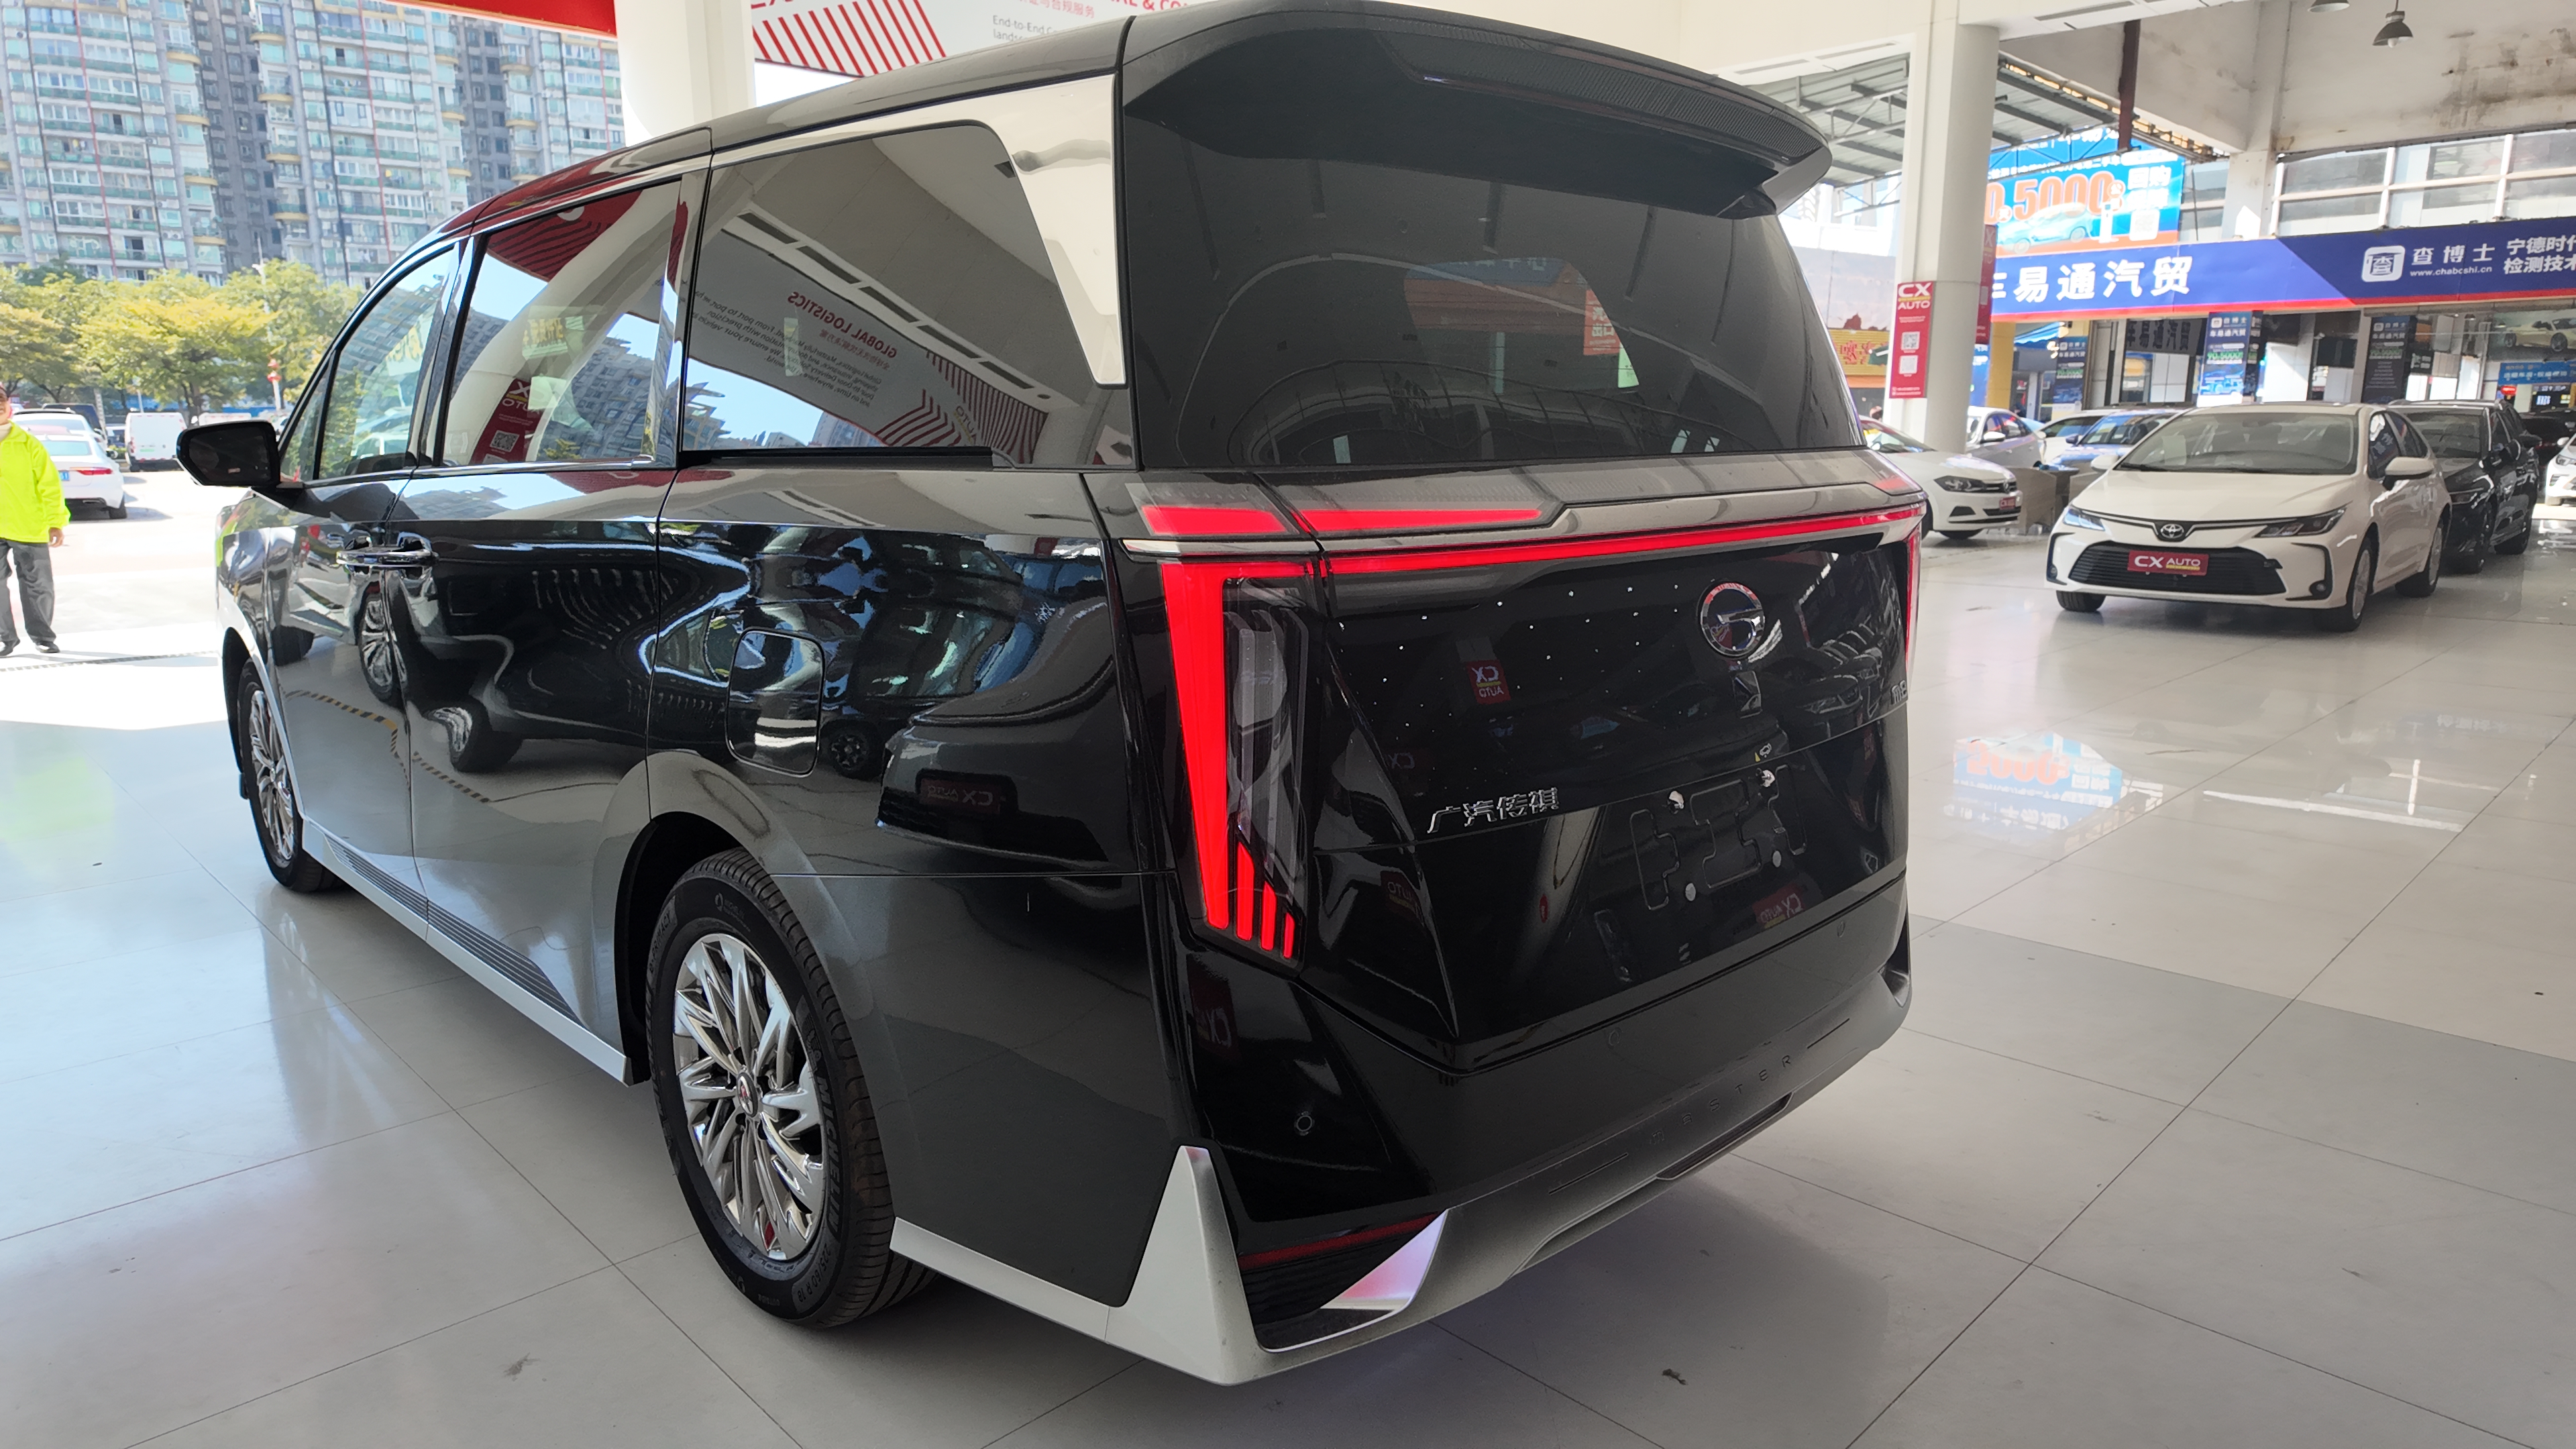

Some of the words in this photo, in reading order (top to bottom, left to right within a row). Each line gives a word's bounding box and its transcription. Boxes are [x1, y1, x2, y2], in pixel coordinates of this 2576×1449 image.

[2412, 244, 2495, 266] 查博士
[1898, 283, 1931, 298] CX
[1898, 300, 1930, 311] AUTO
[2134, 555, 2164, 568] CX
[2166, 557, 2201, 567] AUTO
[1427, 787, 1560, 834] 广汽传祺
[816, 1075, 841, 1234] MICHELIN
